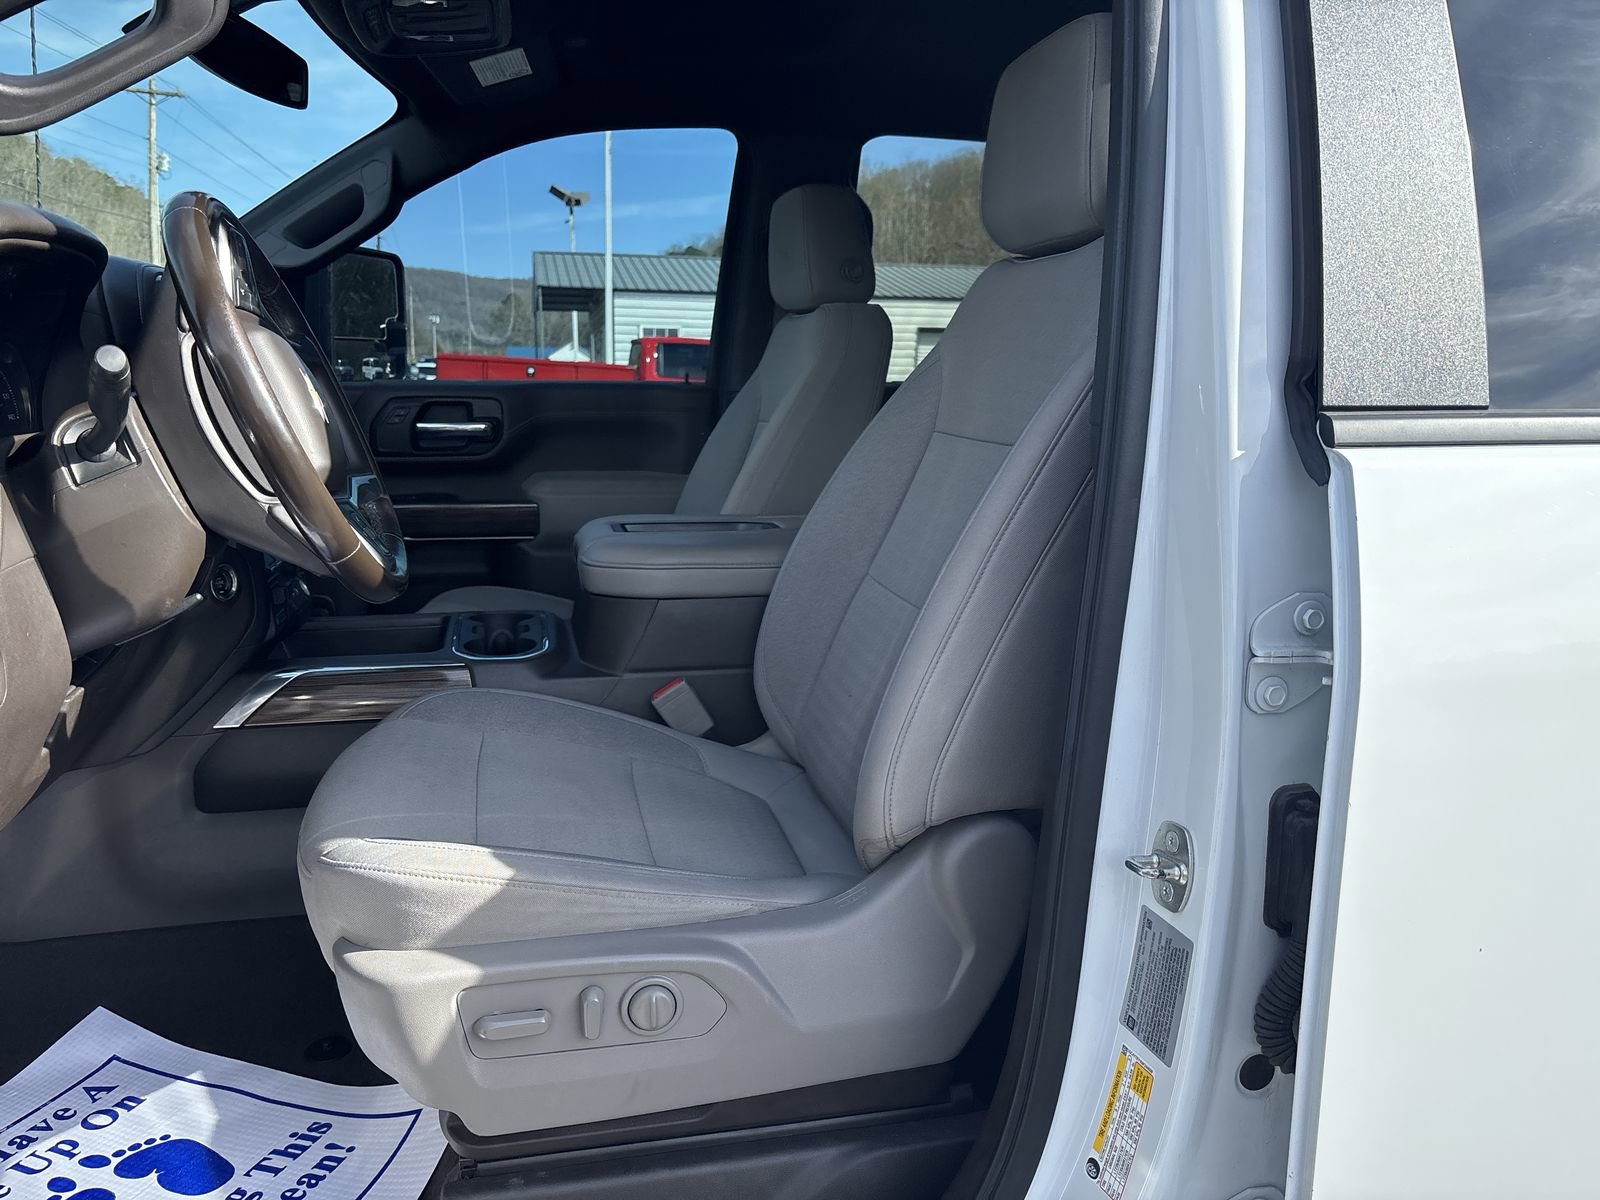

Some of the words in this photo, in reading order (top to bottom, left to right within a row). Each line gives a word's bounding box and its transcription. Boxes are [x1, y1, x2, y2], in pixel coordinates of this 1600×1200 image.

[82, 1085, 120, 1104] A
[5, 1139, 81, 1175] Up
[80, 1095, 148, 1130] On
[242, 1121, 333, 1178] This
